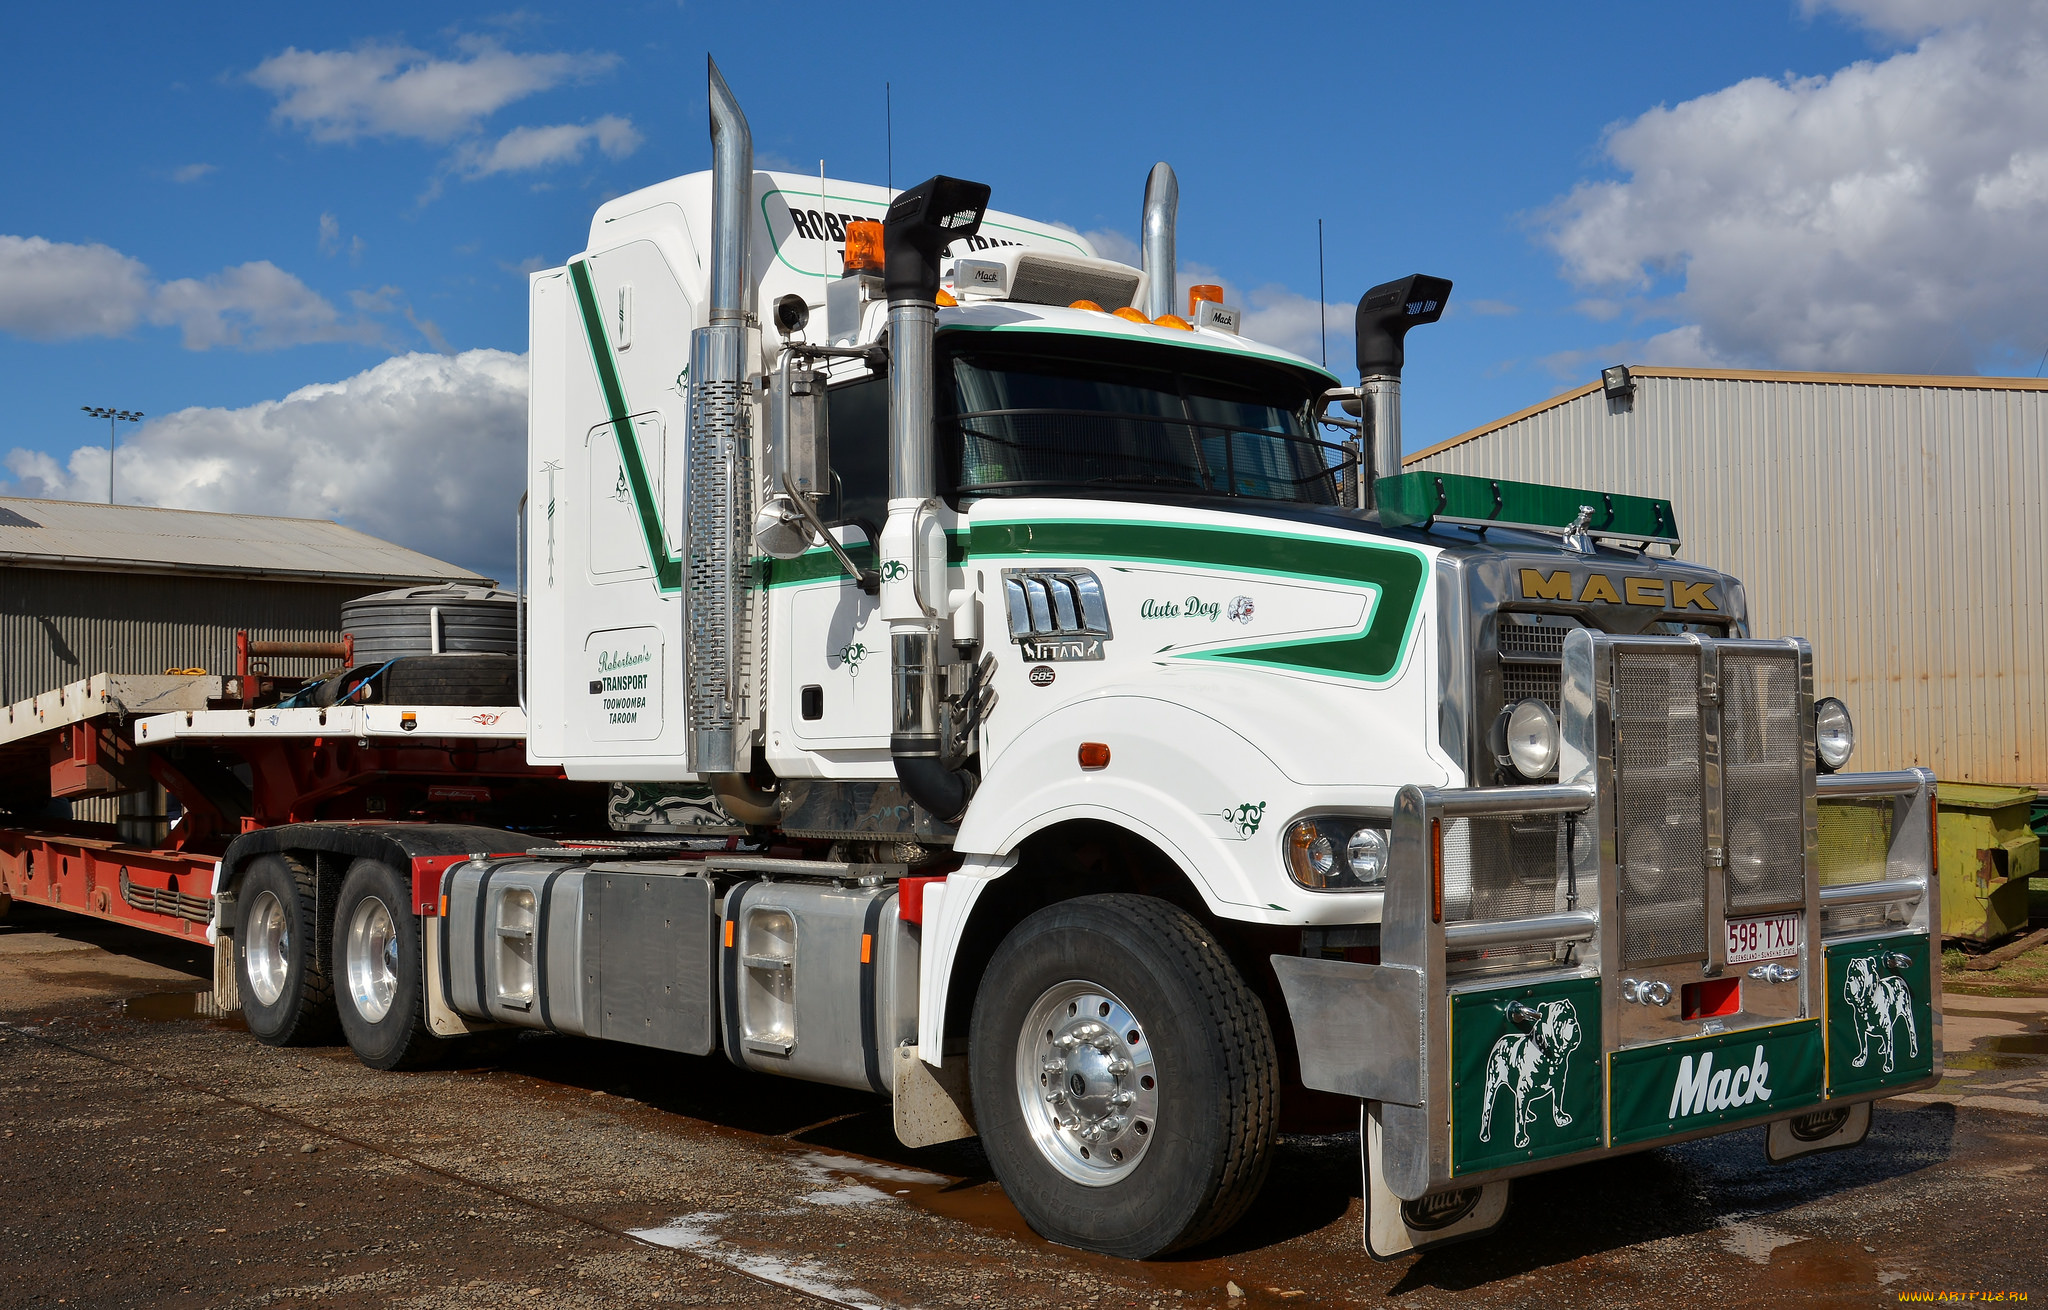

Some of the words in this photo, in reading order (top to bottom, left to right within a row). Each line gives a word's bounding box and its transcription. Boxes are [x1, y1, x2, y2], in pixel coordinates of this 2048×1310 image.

[975, 270, 998, 283] Mack
[1212, 312, 1232, 325] Mack
[1519, 568, 1719, 611] MACK
[1140, 598, 1181, 620] Auto
[1184, 596, 1221, 622] Dog
[598, 644, 652, 673] Robertson's
[602, 674, 648, 691] TRANSPORT
[1030, 671, 1055, 681] 685
[603, 697, 646, 709] TOOWOOMBA
[609, 712, 637, 725] TAROOM
[1668, 1044, 1772, 1119] Mack
